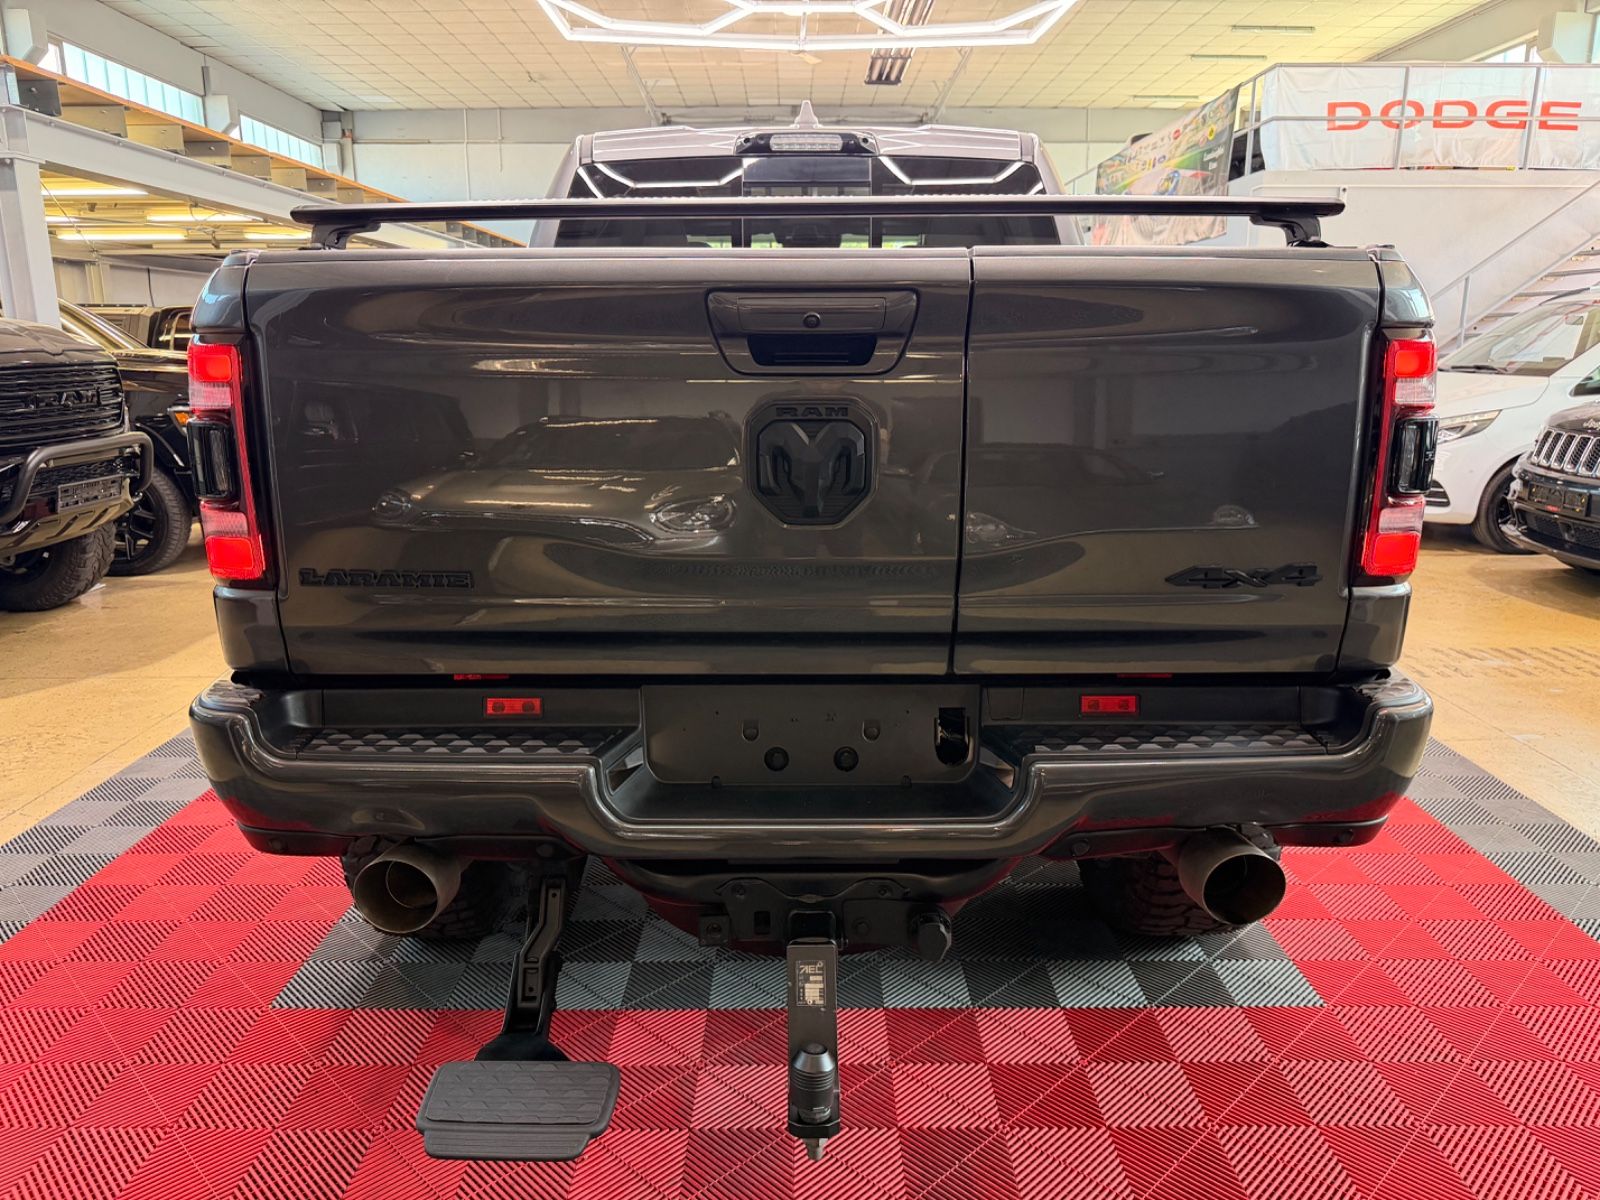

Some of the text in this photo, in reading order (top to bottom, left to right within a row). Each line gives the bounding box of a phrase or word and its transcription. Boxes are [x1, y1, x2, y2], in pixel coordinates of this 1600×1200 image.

[1327, 100, 1582, 131] DODGE
[34, 387, 101, 409] RAM
[775, 406, 849, 417] RAM
[299, 568, 474, 589] LARAMIE
